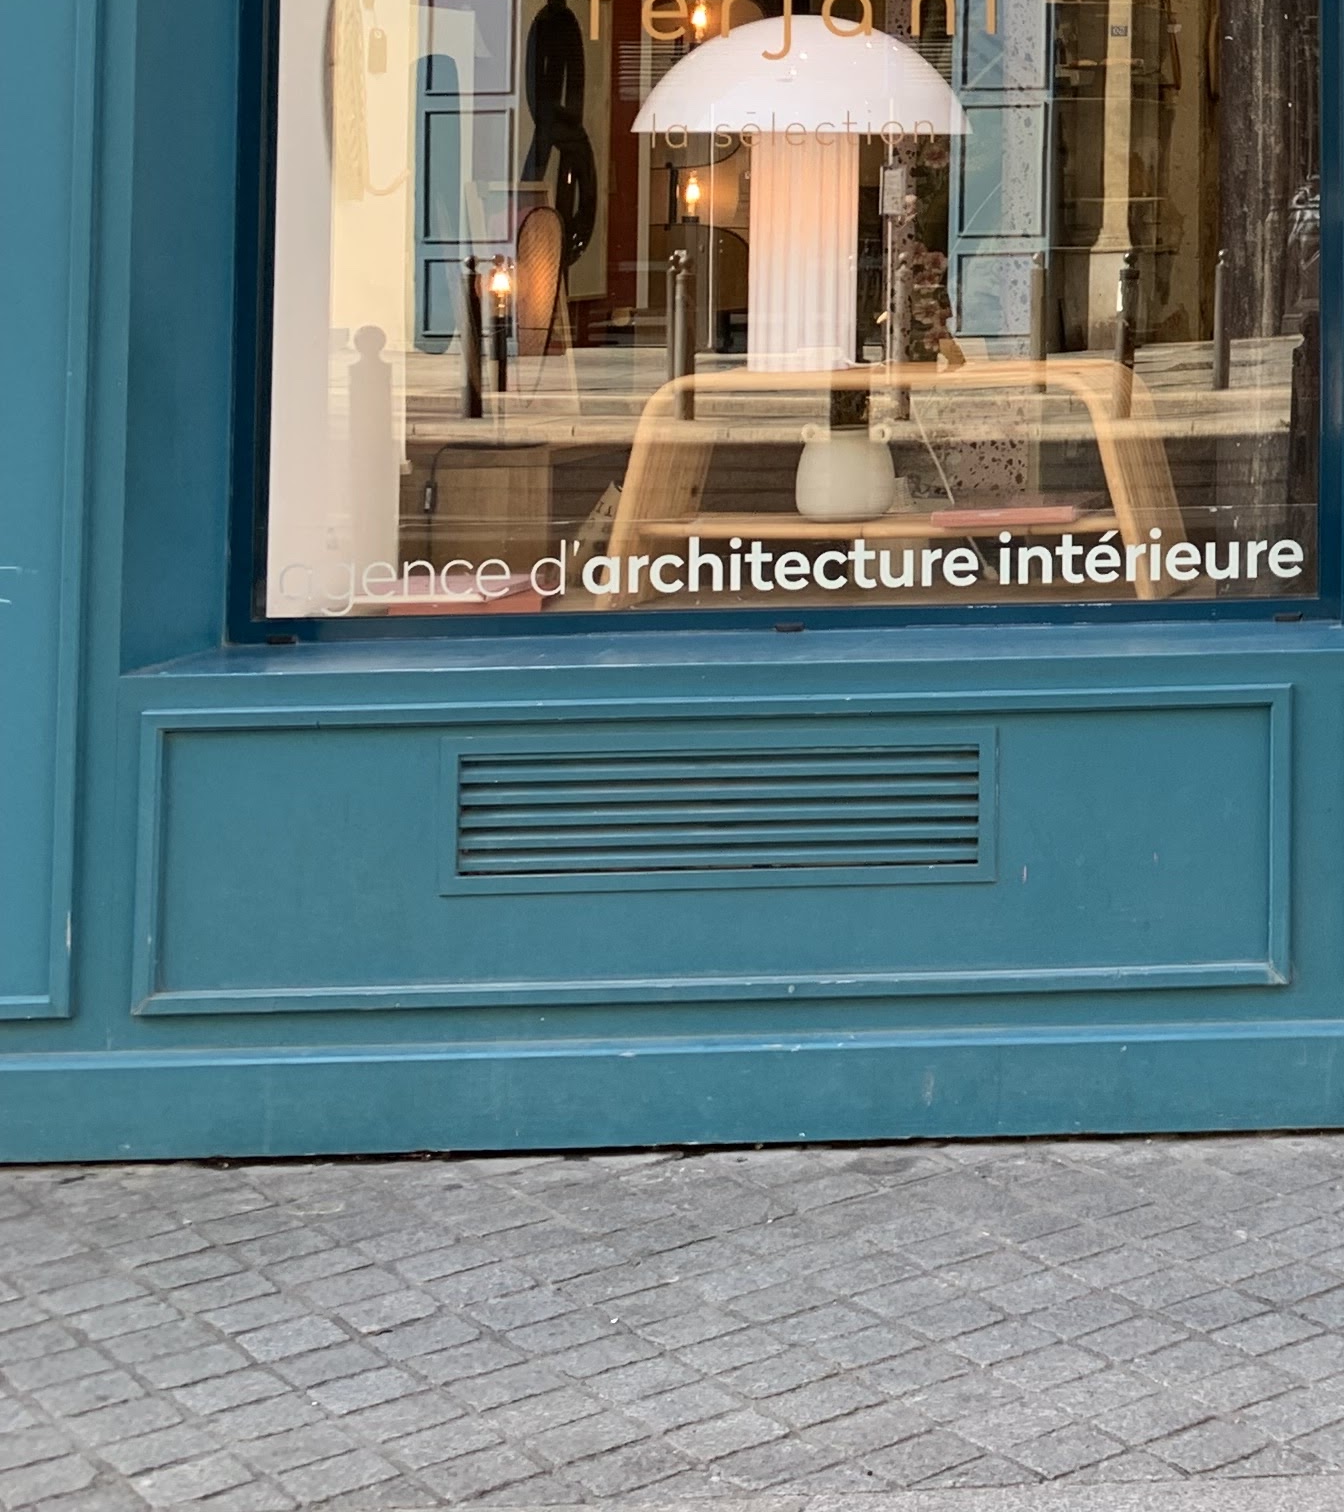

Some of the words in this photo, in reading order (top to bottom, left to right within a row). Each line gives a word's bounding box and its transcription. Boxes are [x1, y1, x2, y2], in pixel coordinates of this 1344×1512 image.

[652, 113, 688, 149] la
[531, 536, 979, 596] d'architecture
[999, 527, 1304, 586] intérieure
